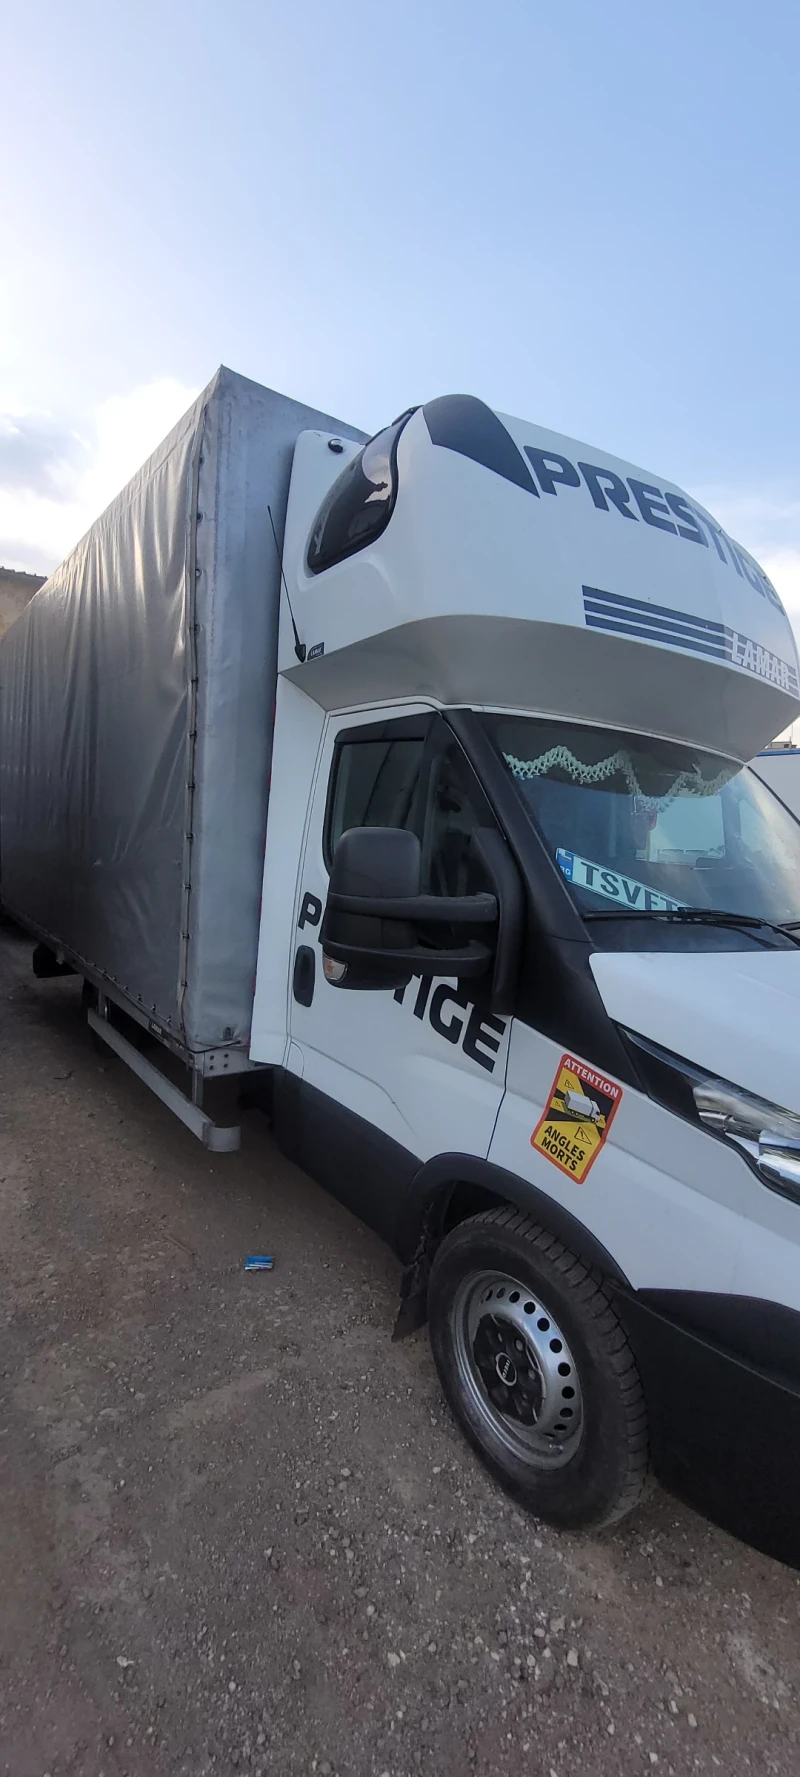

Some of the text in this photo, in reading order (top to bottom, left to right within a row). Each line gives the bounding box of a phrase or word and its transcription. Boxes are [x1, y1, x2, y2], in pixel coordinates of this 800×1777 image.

[524, 446, 785, 616] PRESTIGE
[731, 632, 790, 690] LAMAR
[564, 1058, 619, 1098] ATTENTION
[541, 1137, 578, 1171] MORTS
[544, 1125, 586, 1161] ANGLES
